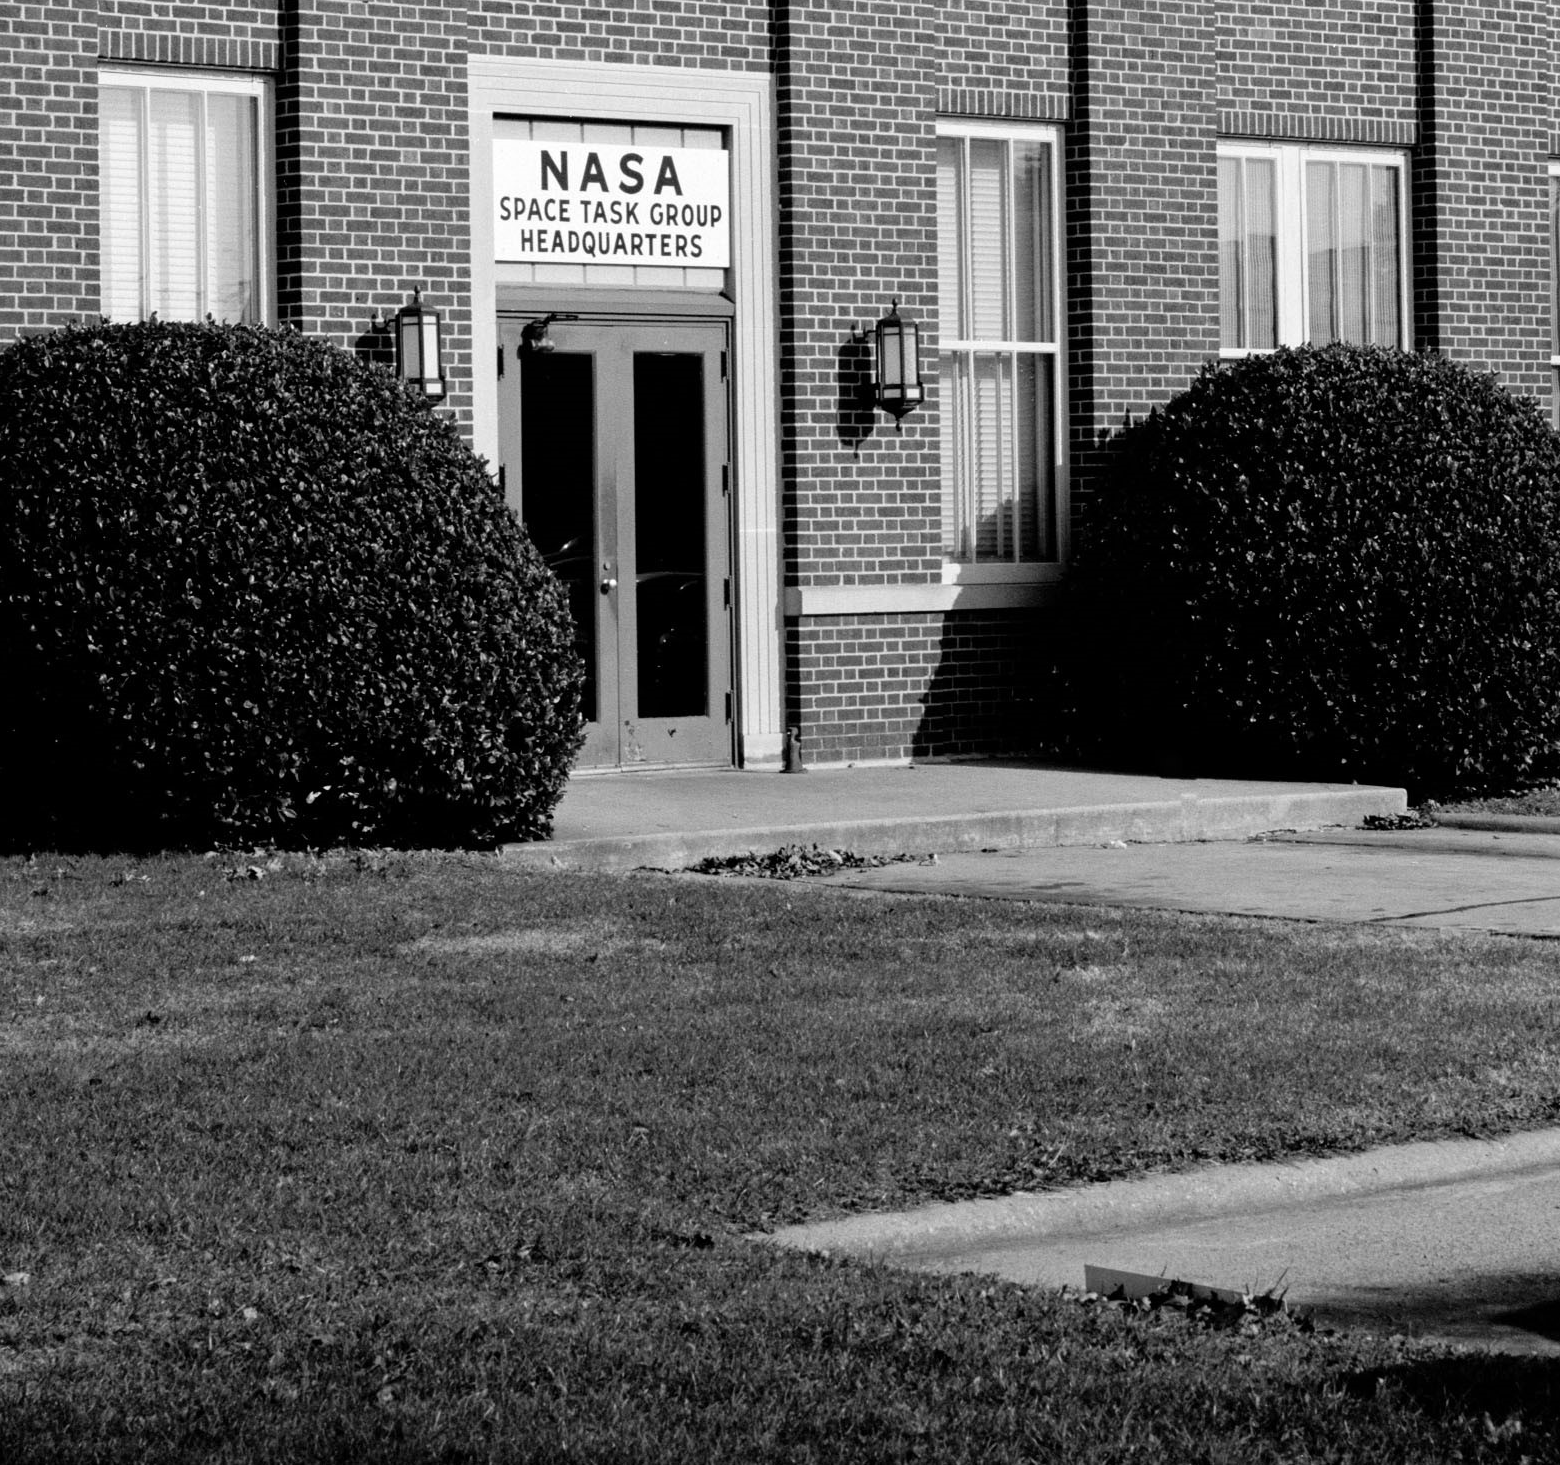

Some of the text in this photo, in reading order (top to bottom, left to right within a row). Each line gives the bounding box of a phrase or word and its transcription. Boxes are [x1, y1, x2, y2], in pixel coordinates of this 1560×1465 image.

[540, 149, 683, 196] NASA
[499, 196, 722, 228] SPACE TASK GROUP
[520, 228, 703, 258] HEADQUARTERS
